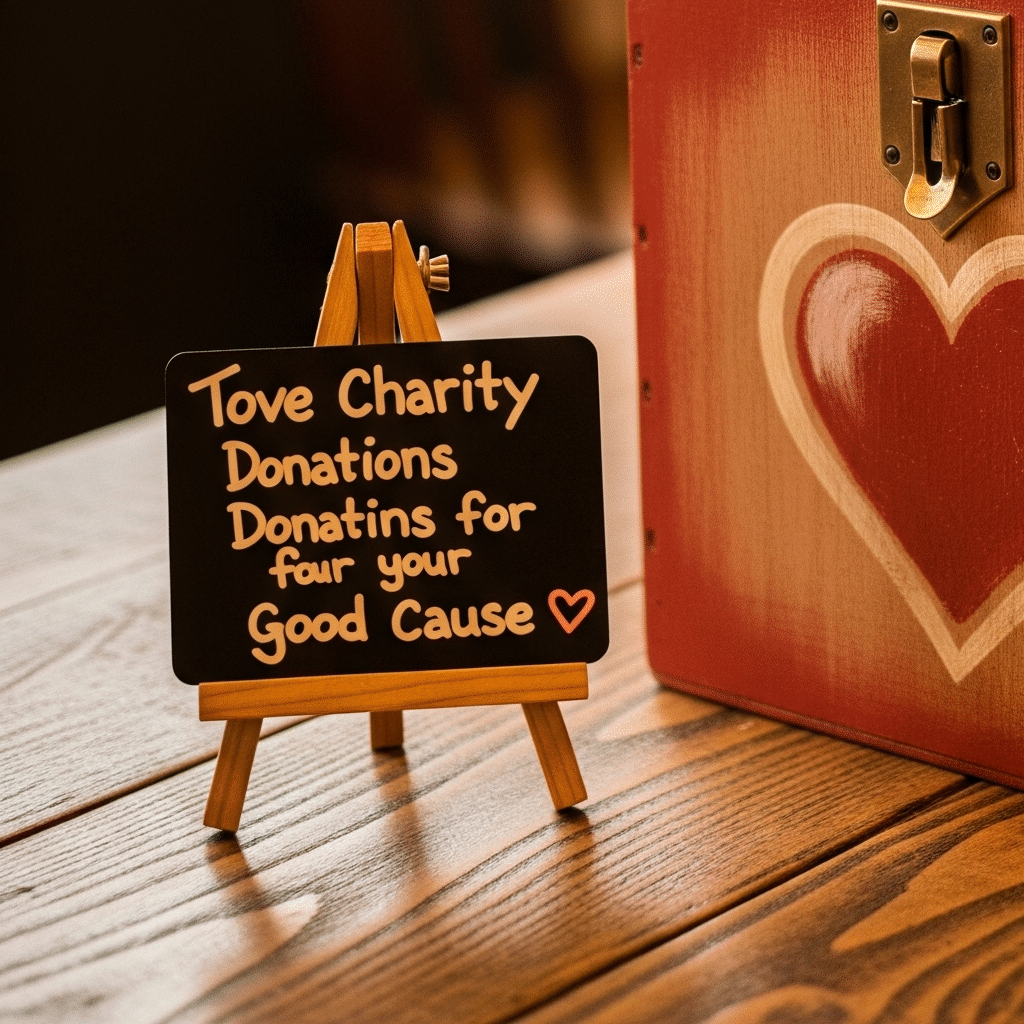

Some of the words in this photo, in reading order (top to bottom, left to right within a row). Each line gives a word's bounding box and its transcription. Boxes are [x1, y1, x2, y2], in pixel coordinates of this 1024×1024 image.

[188, 363, 315, 428] Tove
[338, 360, 540, 431] Charity
[221, 436, 458, 493] Donations
[226, 497, 437, 550] Donatins
[455, 490, 537, 536] for
[377, 548, 473, 593] your
[247, 593, 369, 665] Good
[391, 599, 536, 642] Cause
